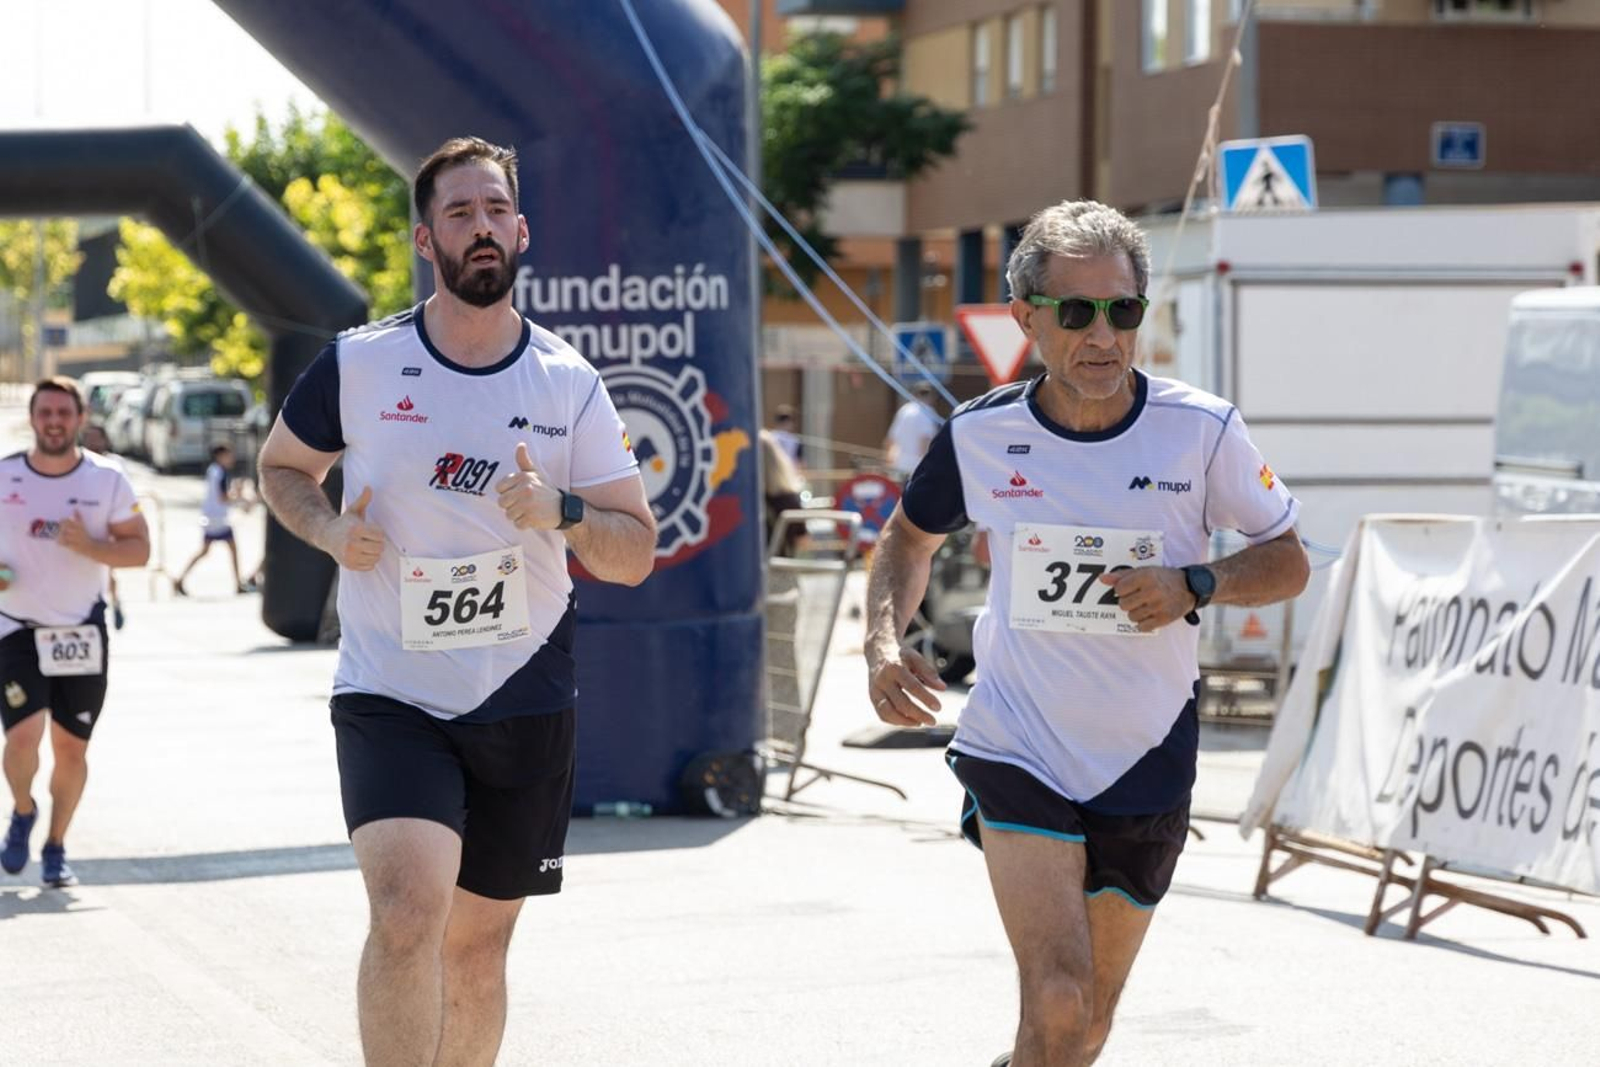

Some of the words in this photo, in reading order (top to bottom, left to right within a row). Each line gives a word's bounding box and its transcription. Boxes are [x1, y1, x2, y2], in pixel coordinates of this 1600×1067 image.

[515, 263, 729, 313] fundación
[554, 311, 695, 367] mupol
[379, 411, 429, 424] Santander
[532, 422, 567, 439] mupol
[992, 487, 1044, 499] Santander
[1157, 479, 1192, 495] mupol
[424, 580, 505, 627] 564
[1051, 609, 1074, 618] MIGUEL
[52, 641, 90, 662] 603
